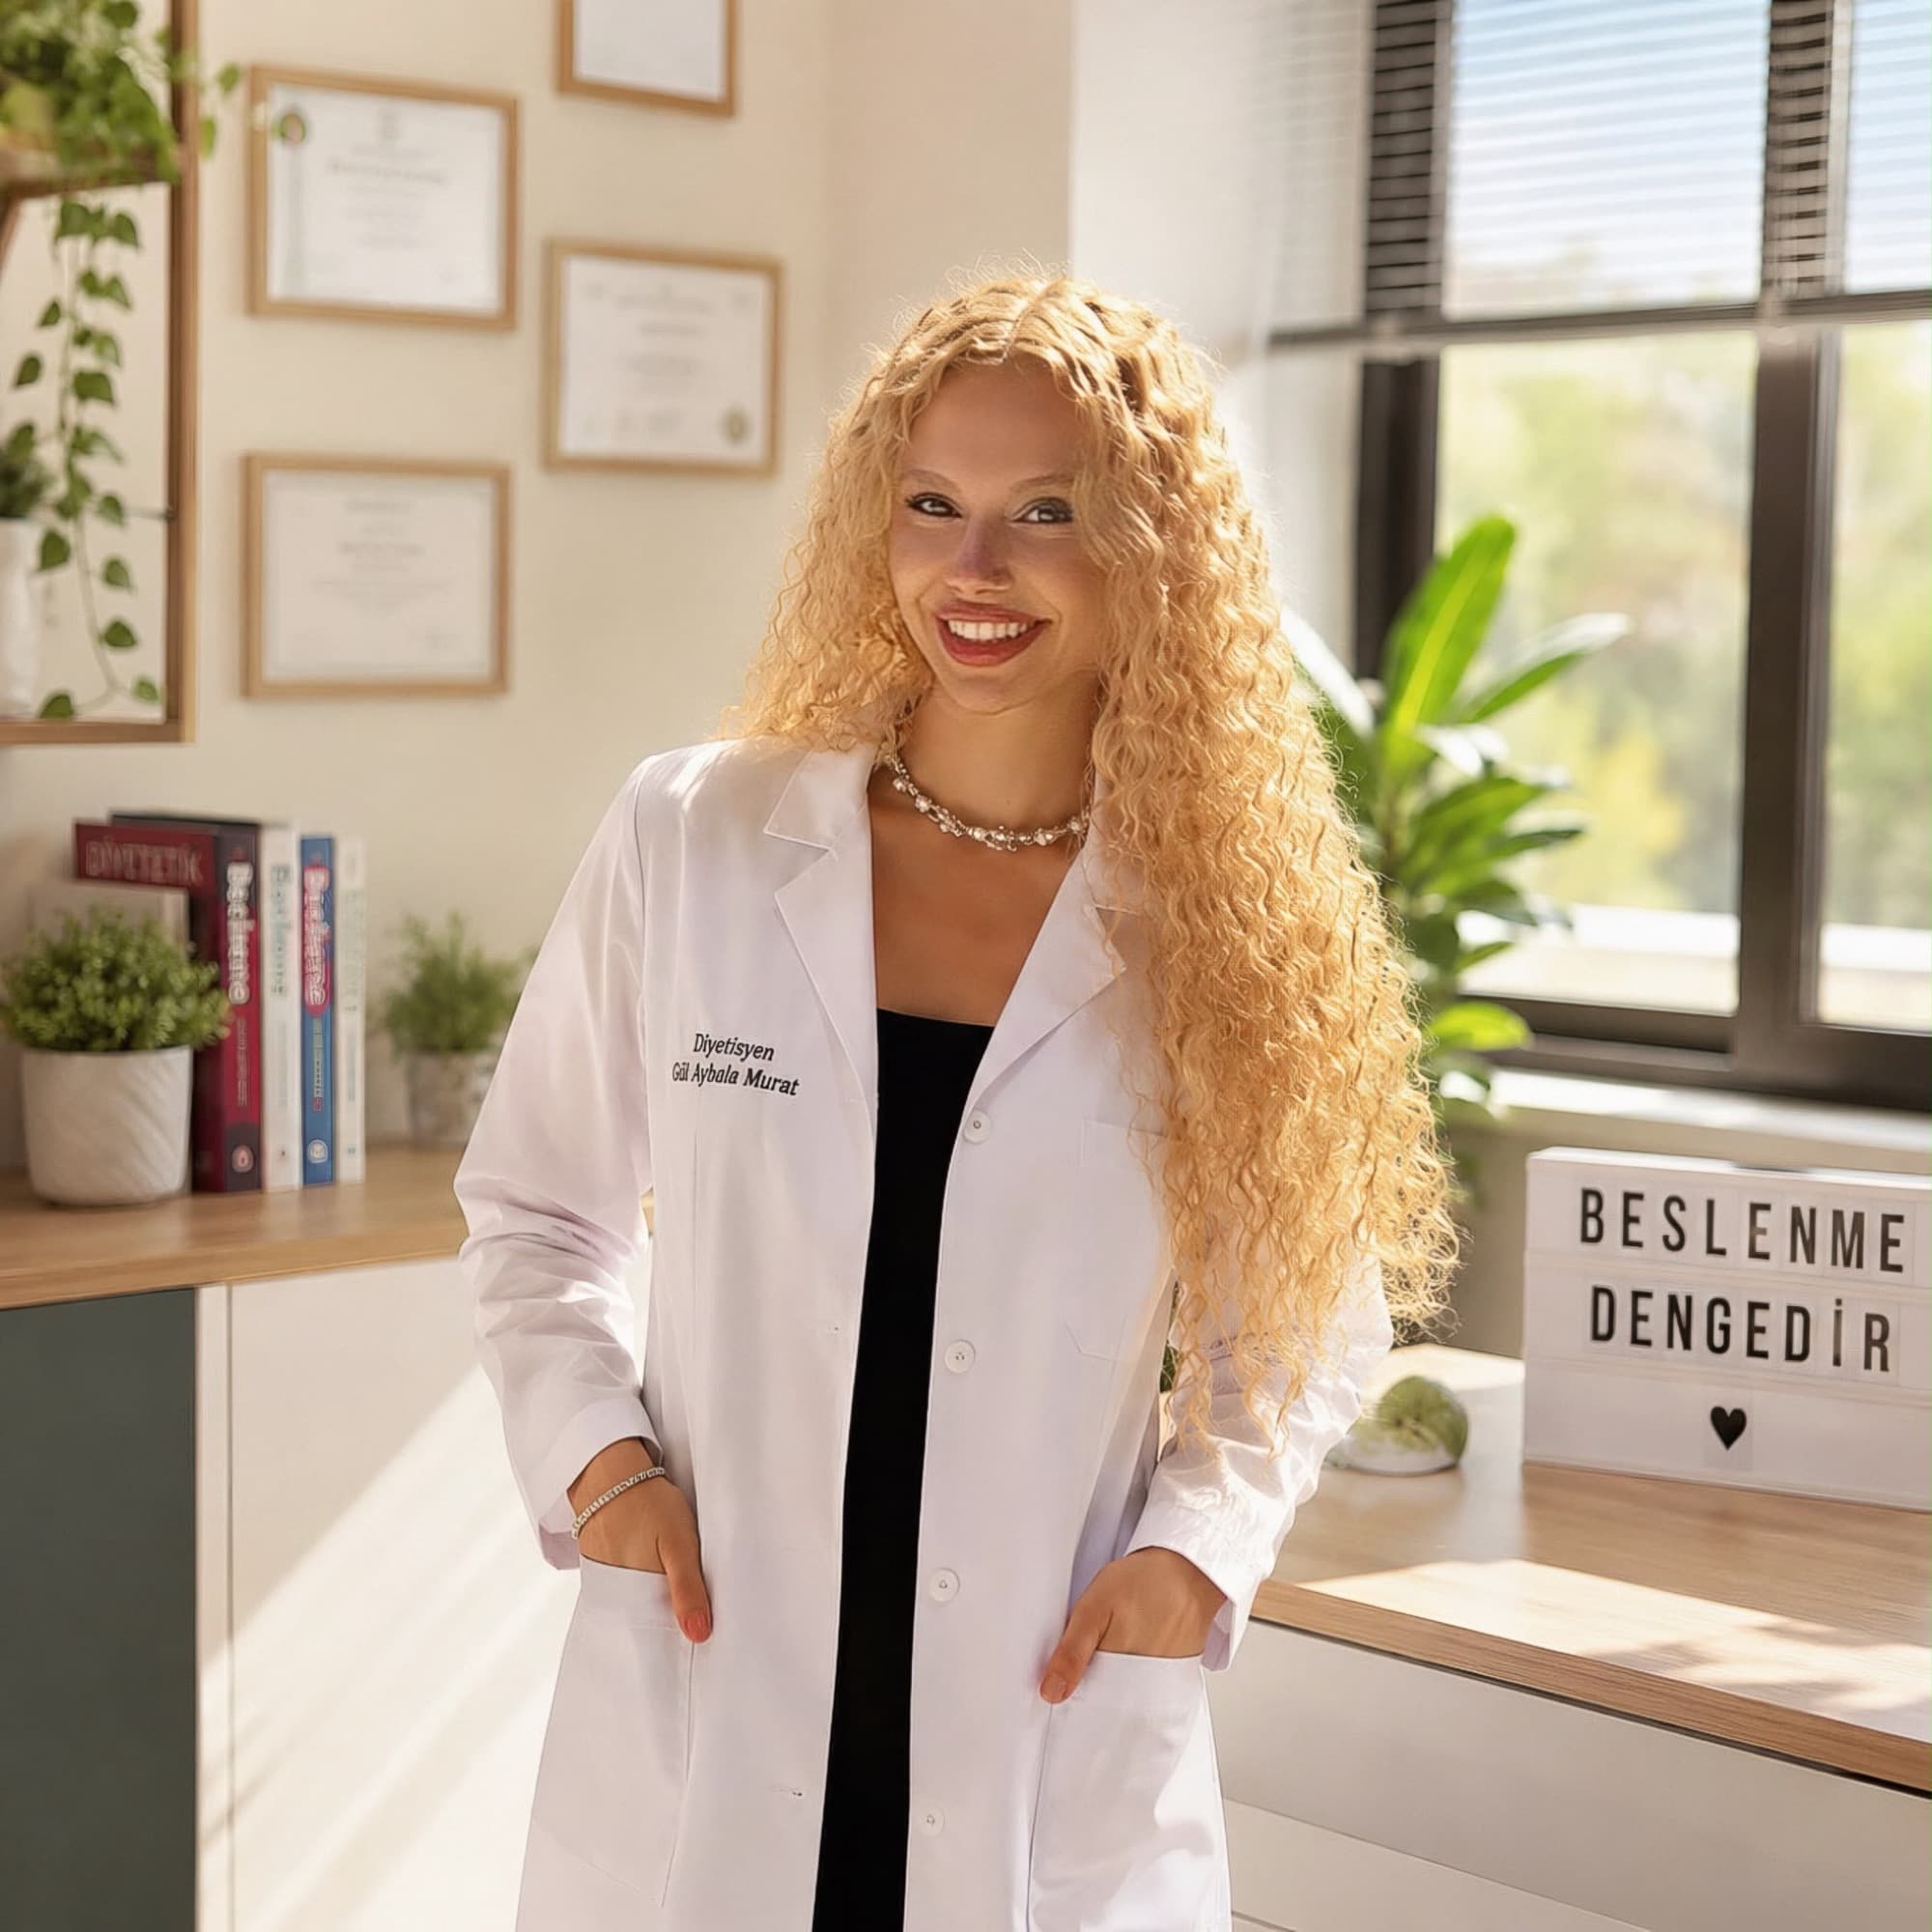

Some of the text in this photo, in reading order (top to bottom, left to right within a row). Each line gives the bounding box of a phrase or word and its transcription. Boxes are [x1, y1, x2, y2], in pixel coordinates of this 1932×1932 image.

[694, 1032, 775, 1063] Diyetisyen
[671, 1061, 801, 1096] Gül Aybala Murat
[1579, 1187, 1905, 1273] BESLENME
[1589, 1285, 1891, 1373] DENGEDİR
